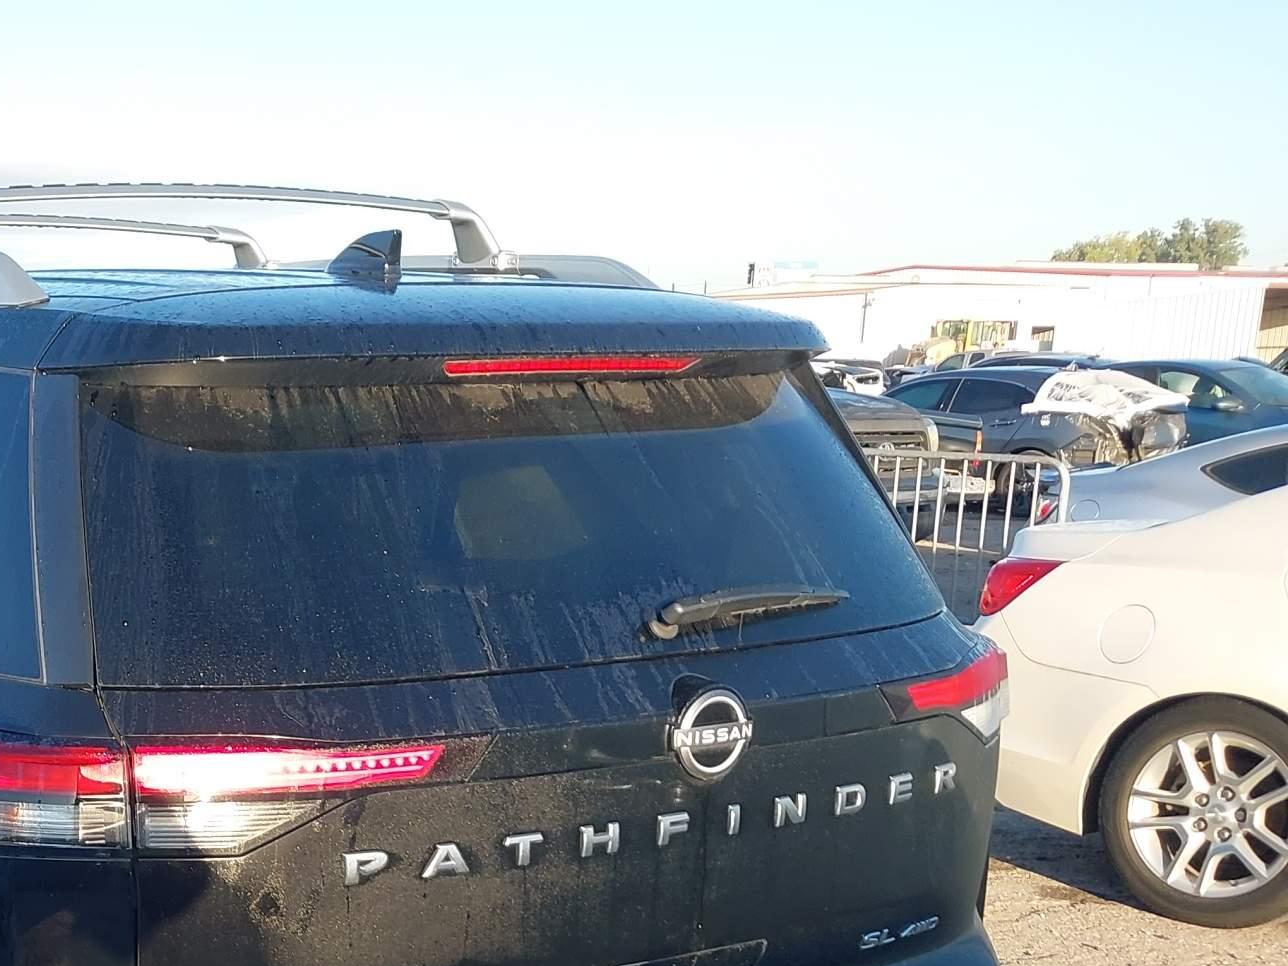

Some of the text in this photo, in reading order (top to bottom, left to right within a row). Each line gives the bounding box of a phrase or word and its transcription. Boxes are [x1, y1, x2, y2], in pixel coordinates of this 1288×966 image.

[675, 722, 753, 748] NISSAN
[344, 761, 958, 886] PATHFINDER
[859, 928, 897, 950] SL
